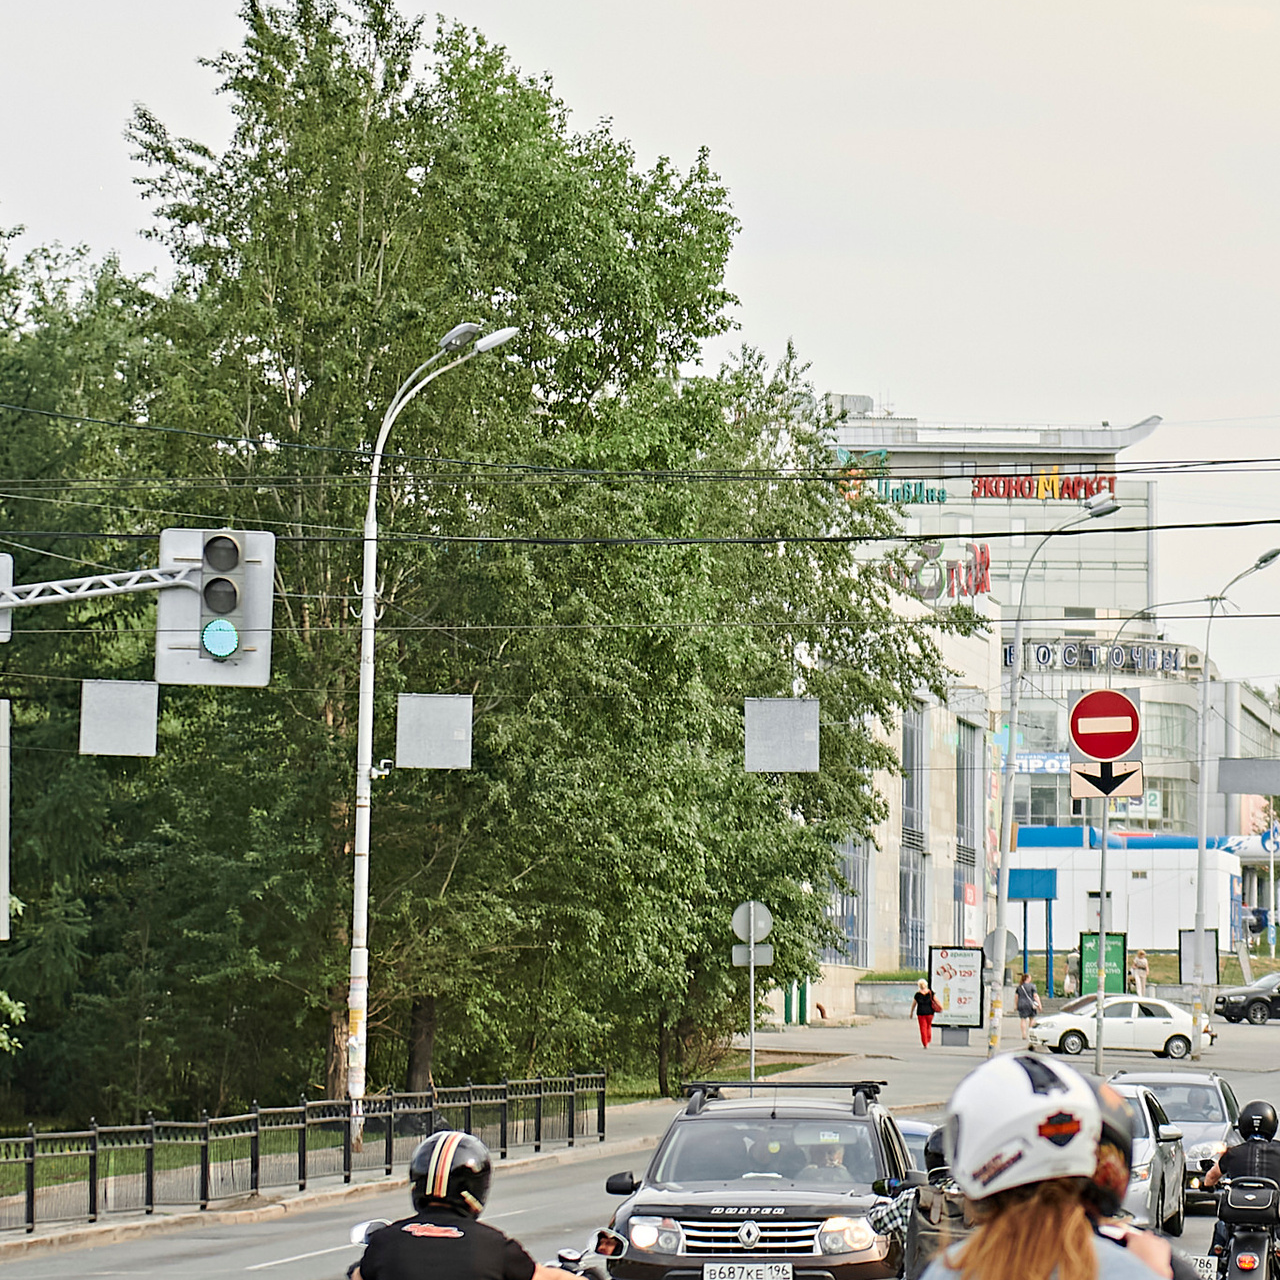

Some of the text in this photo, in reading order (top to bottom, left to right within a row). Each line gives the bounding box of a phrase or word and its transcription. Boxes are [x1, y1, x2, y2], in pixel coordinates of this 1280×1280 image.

[1007, 644, 1182, 672] ВОСТОЧНЫ
[1192, 1258, 1213, 1269] 786
[709, 1265, 788, 1280] В687КЕ 196
